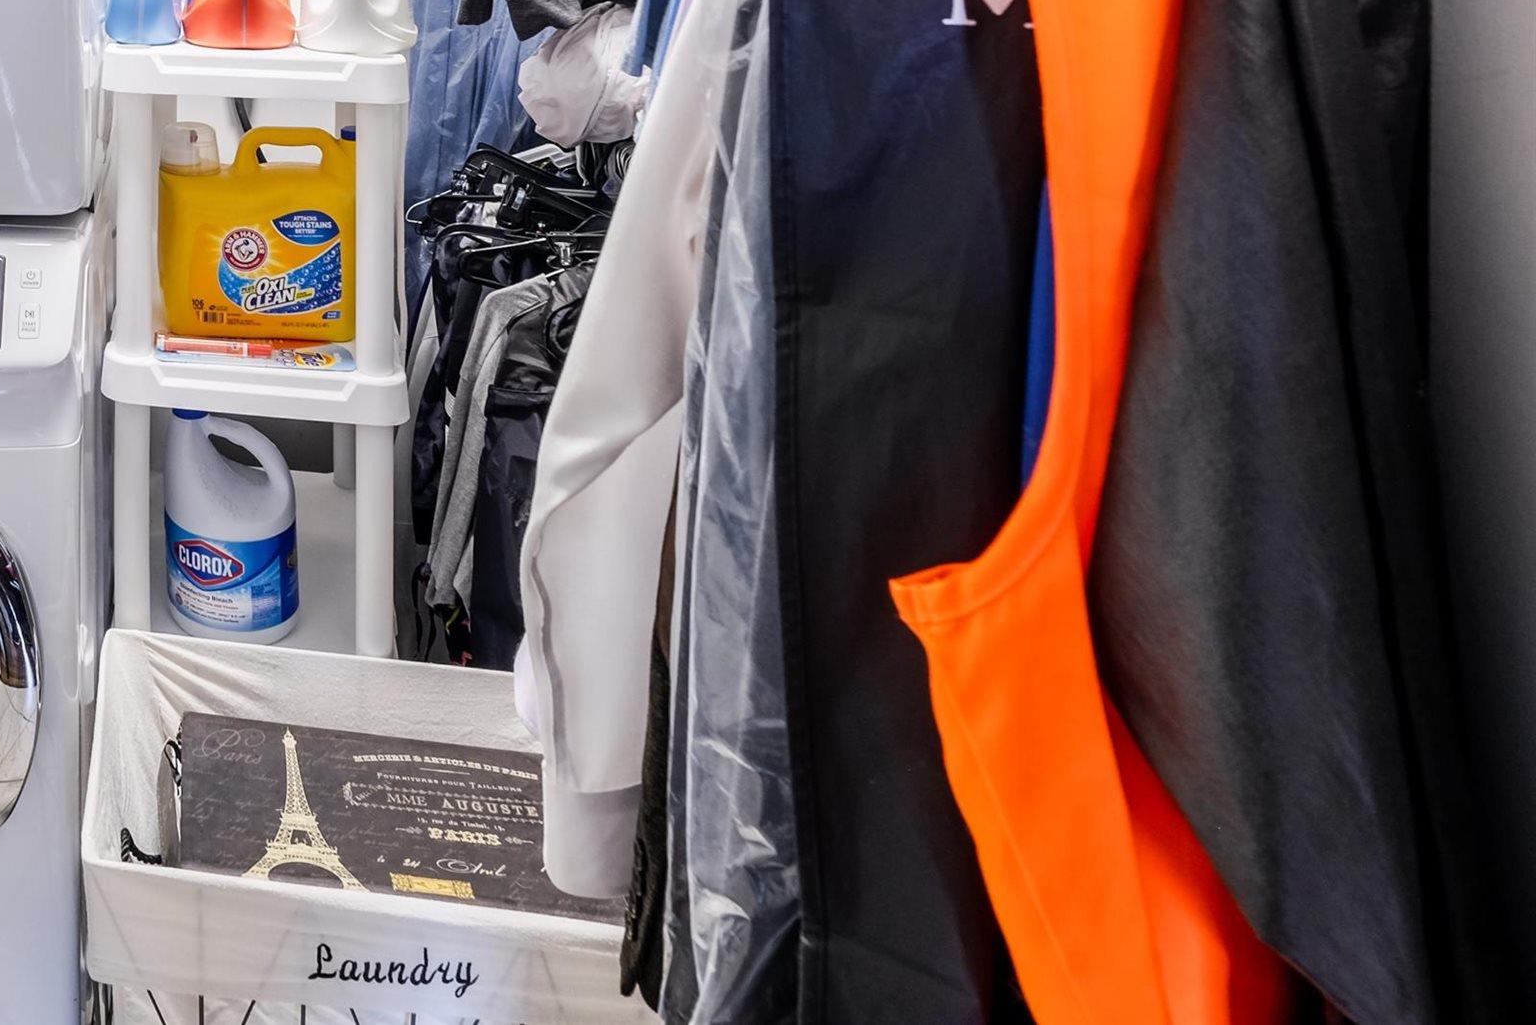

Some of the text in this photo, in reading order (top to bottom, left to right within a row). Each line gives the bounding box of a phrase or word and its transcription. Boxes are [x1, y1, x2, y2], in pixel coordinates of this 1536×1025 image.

[279, 221, 332, 229] TOUGH STAINS
[224, 236, 235, 254] ARM
[256, 277, 285, 294] OXI
[244, 287, 296, 311] CLEAN
[178, 544, 233, 578] CLOROX
[211, 595, 234, 604] Bleach
[192, 728, 266, 764] Paris
[353, 754, 412, 763] MERCERIE
[424, 756, 482, 770] ARTICLES
[483, 764, 500, 773] DE
[501, 767, 539, 781] PARIS
[386, 792, 539, 817] MME AUGUSTE
[427, 826, 502, 846] PARIS
[308, 943, 479, 998] Laundry
